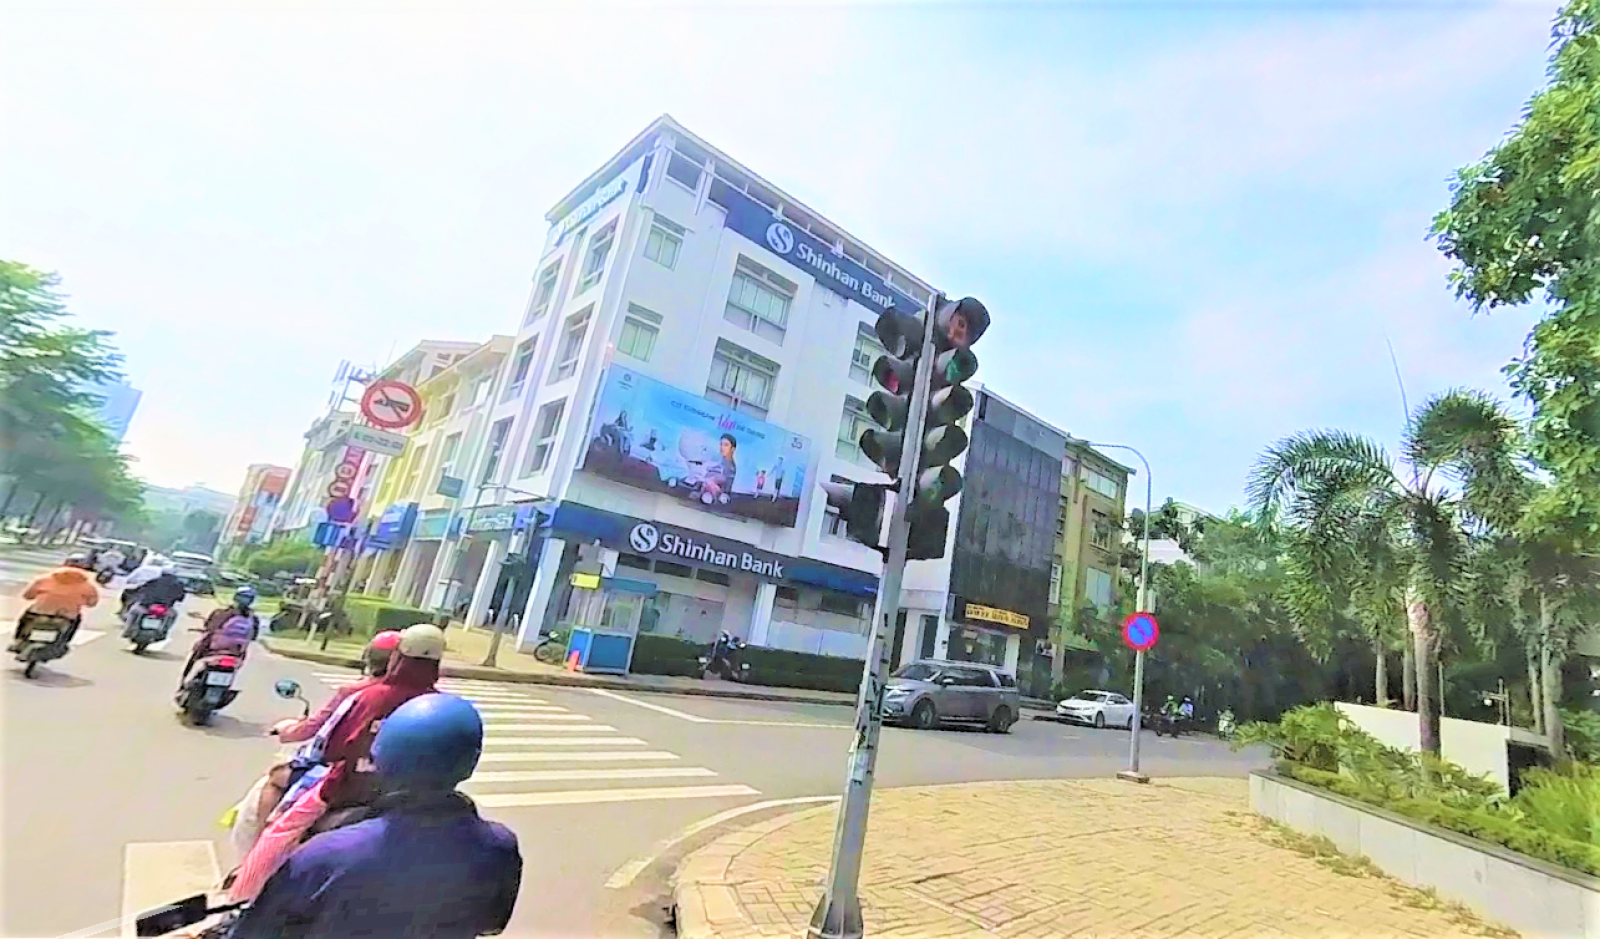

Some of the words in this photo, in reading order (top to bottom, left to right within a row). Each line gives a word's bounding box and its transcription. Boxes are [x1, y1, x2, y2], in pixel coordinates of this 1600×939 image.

[796, 243, 859, 291] Shinhan
[659, 533, 738, 569] Shinhan
[740, 552, 785, 579] Bank
